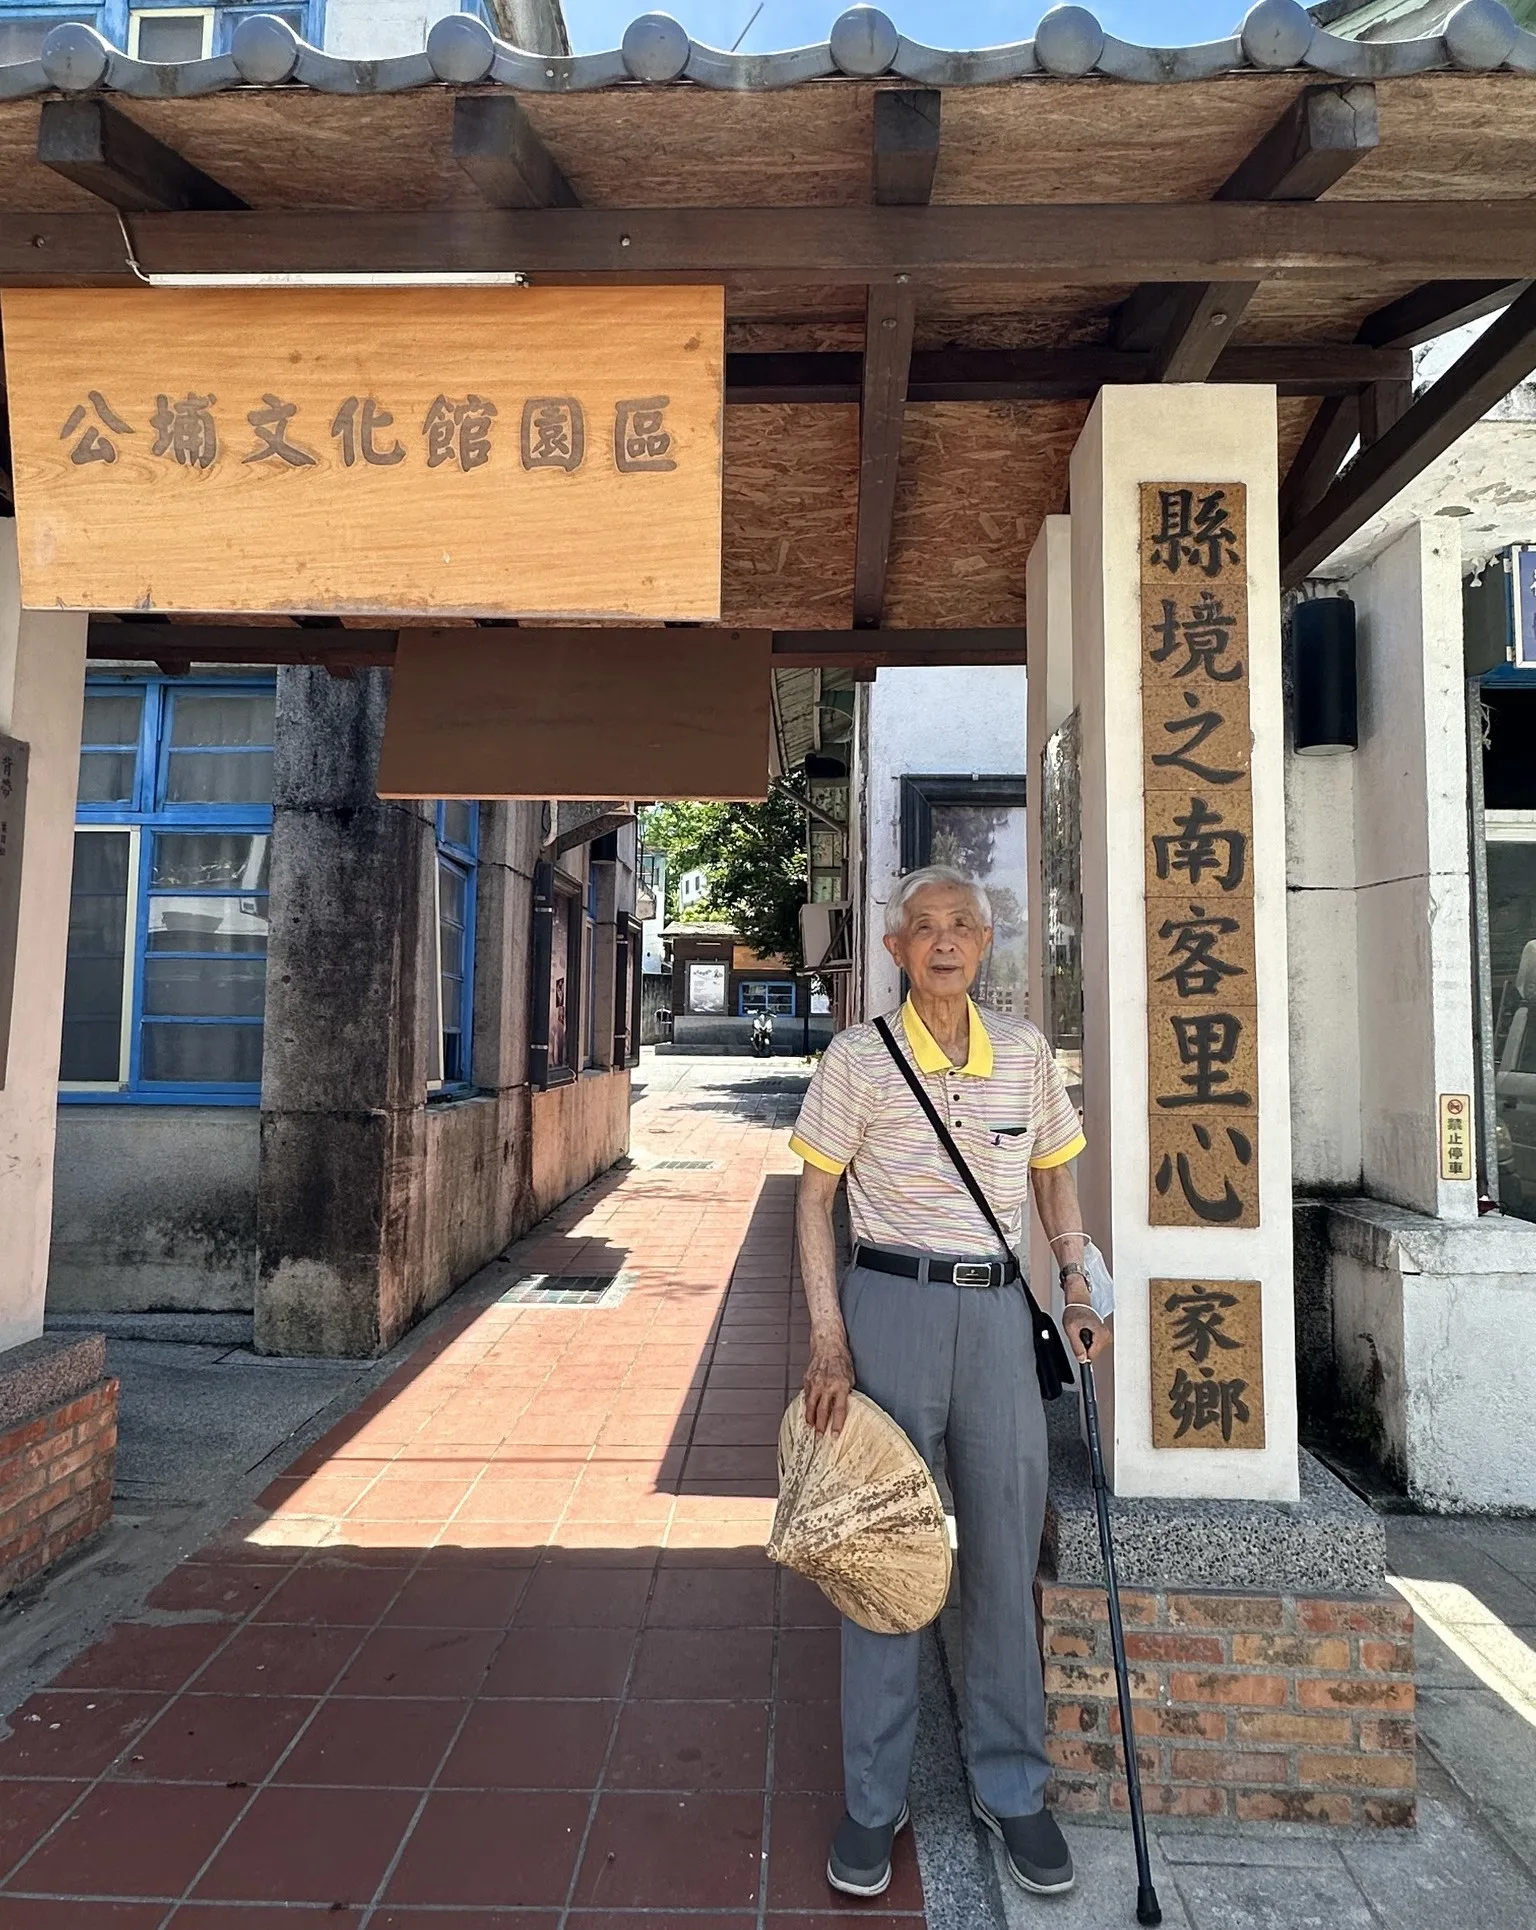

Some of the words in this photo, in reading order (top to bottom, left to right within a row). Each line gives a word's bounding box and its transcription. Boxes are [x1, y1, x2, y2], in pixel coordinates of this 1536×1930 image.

[60, 390, 679, 474] 公埔文化館園區
[1150, 489, 1253, 1222] 縣境之南客里心
[1447, 1117, 1463, 1174] 禁止停車
[1165, 1285, 1247, 1441] 家鄉
